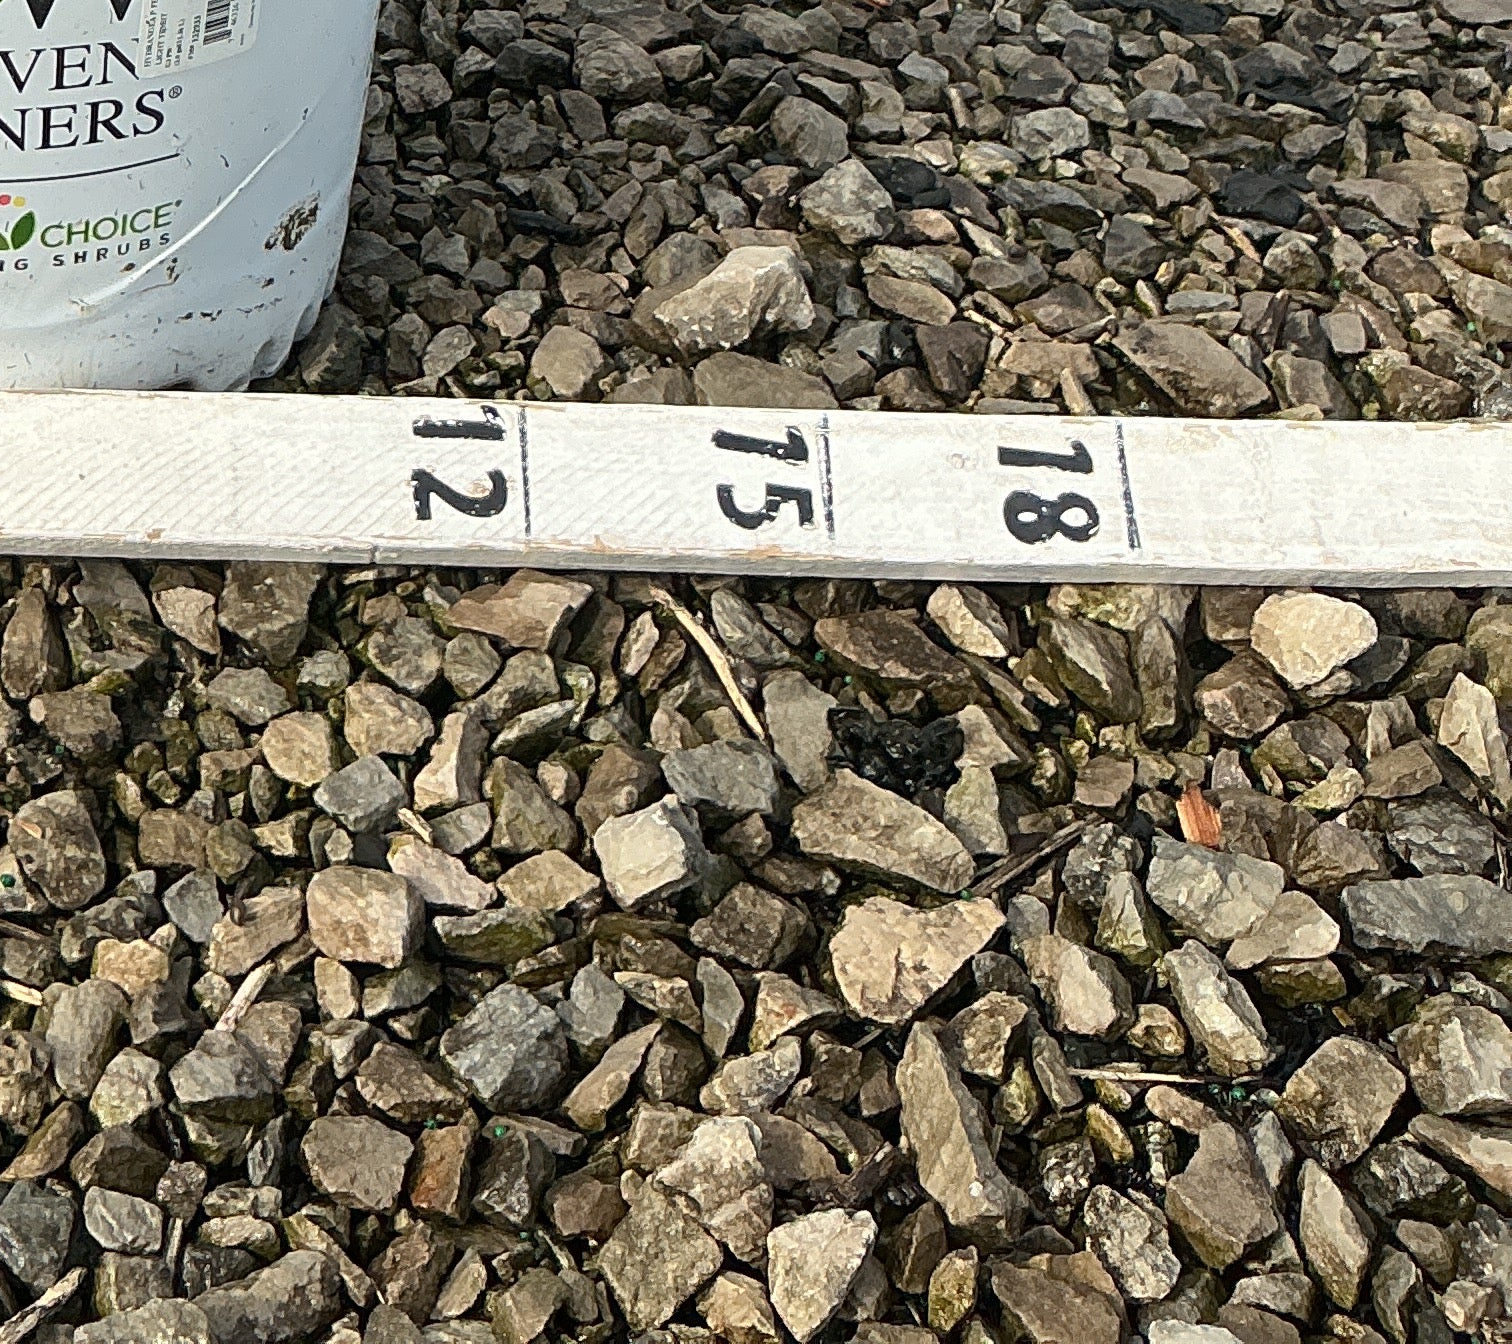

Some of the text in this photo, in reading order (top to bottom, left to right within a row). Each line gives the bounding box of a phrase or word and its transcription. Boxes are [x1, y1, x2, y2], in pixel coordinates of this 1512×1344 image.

[40, 200, 182, 249] CHOICE
[52, 232, 172, 268] SHRUBS
[410, 403, 508, 521] 12
[710, 424, 815, 530] 15
[997, 439, 1100, 545] 18
